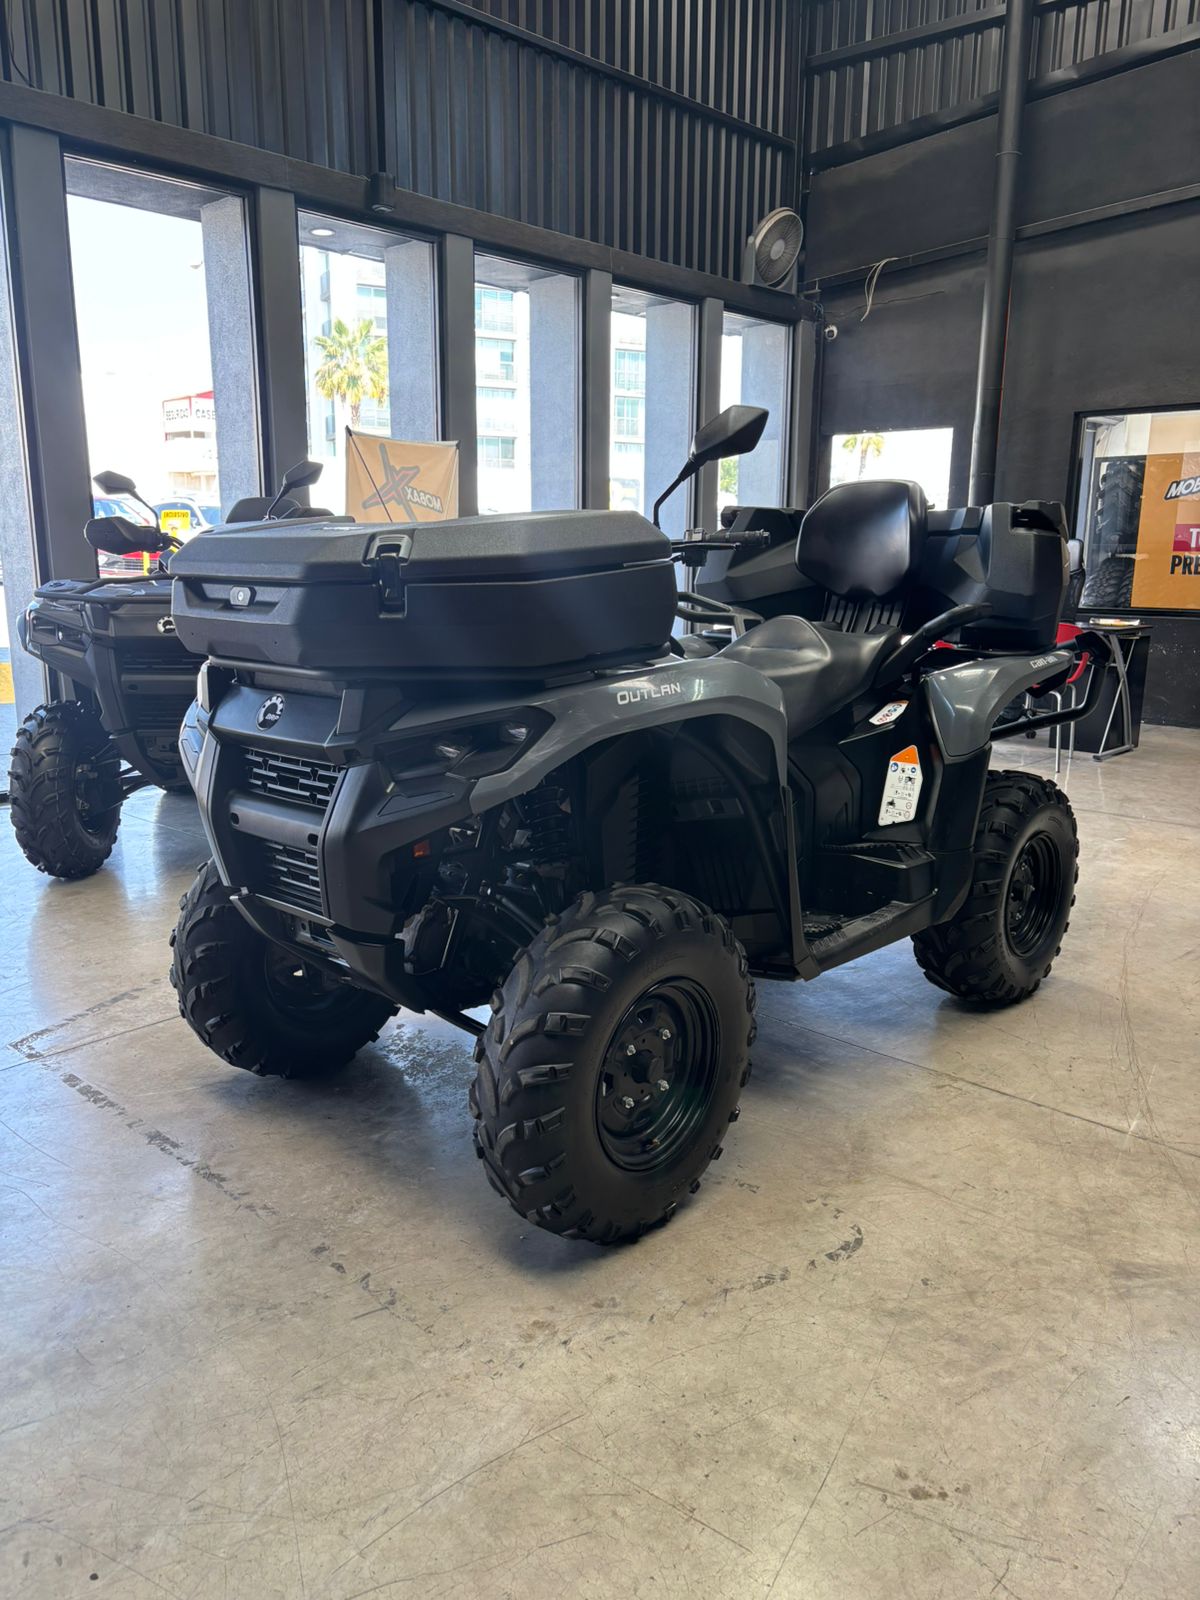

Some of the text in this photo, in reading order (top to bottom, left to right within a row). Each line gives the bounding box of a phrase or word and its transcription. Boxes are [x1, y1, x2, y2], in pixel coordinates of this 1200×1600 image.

[1189, 527, 1200, 549] T
[1169, 554, 1200, 576] PRE
[616, 682, 681, 706] OUTLAN
